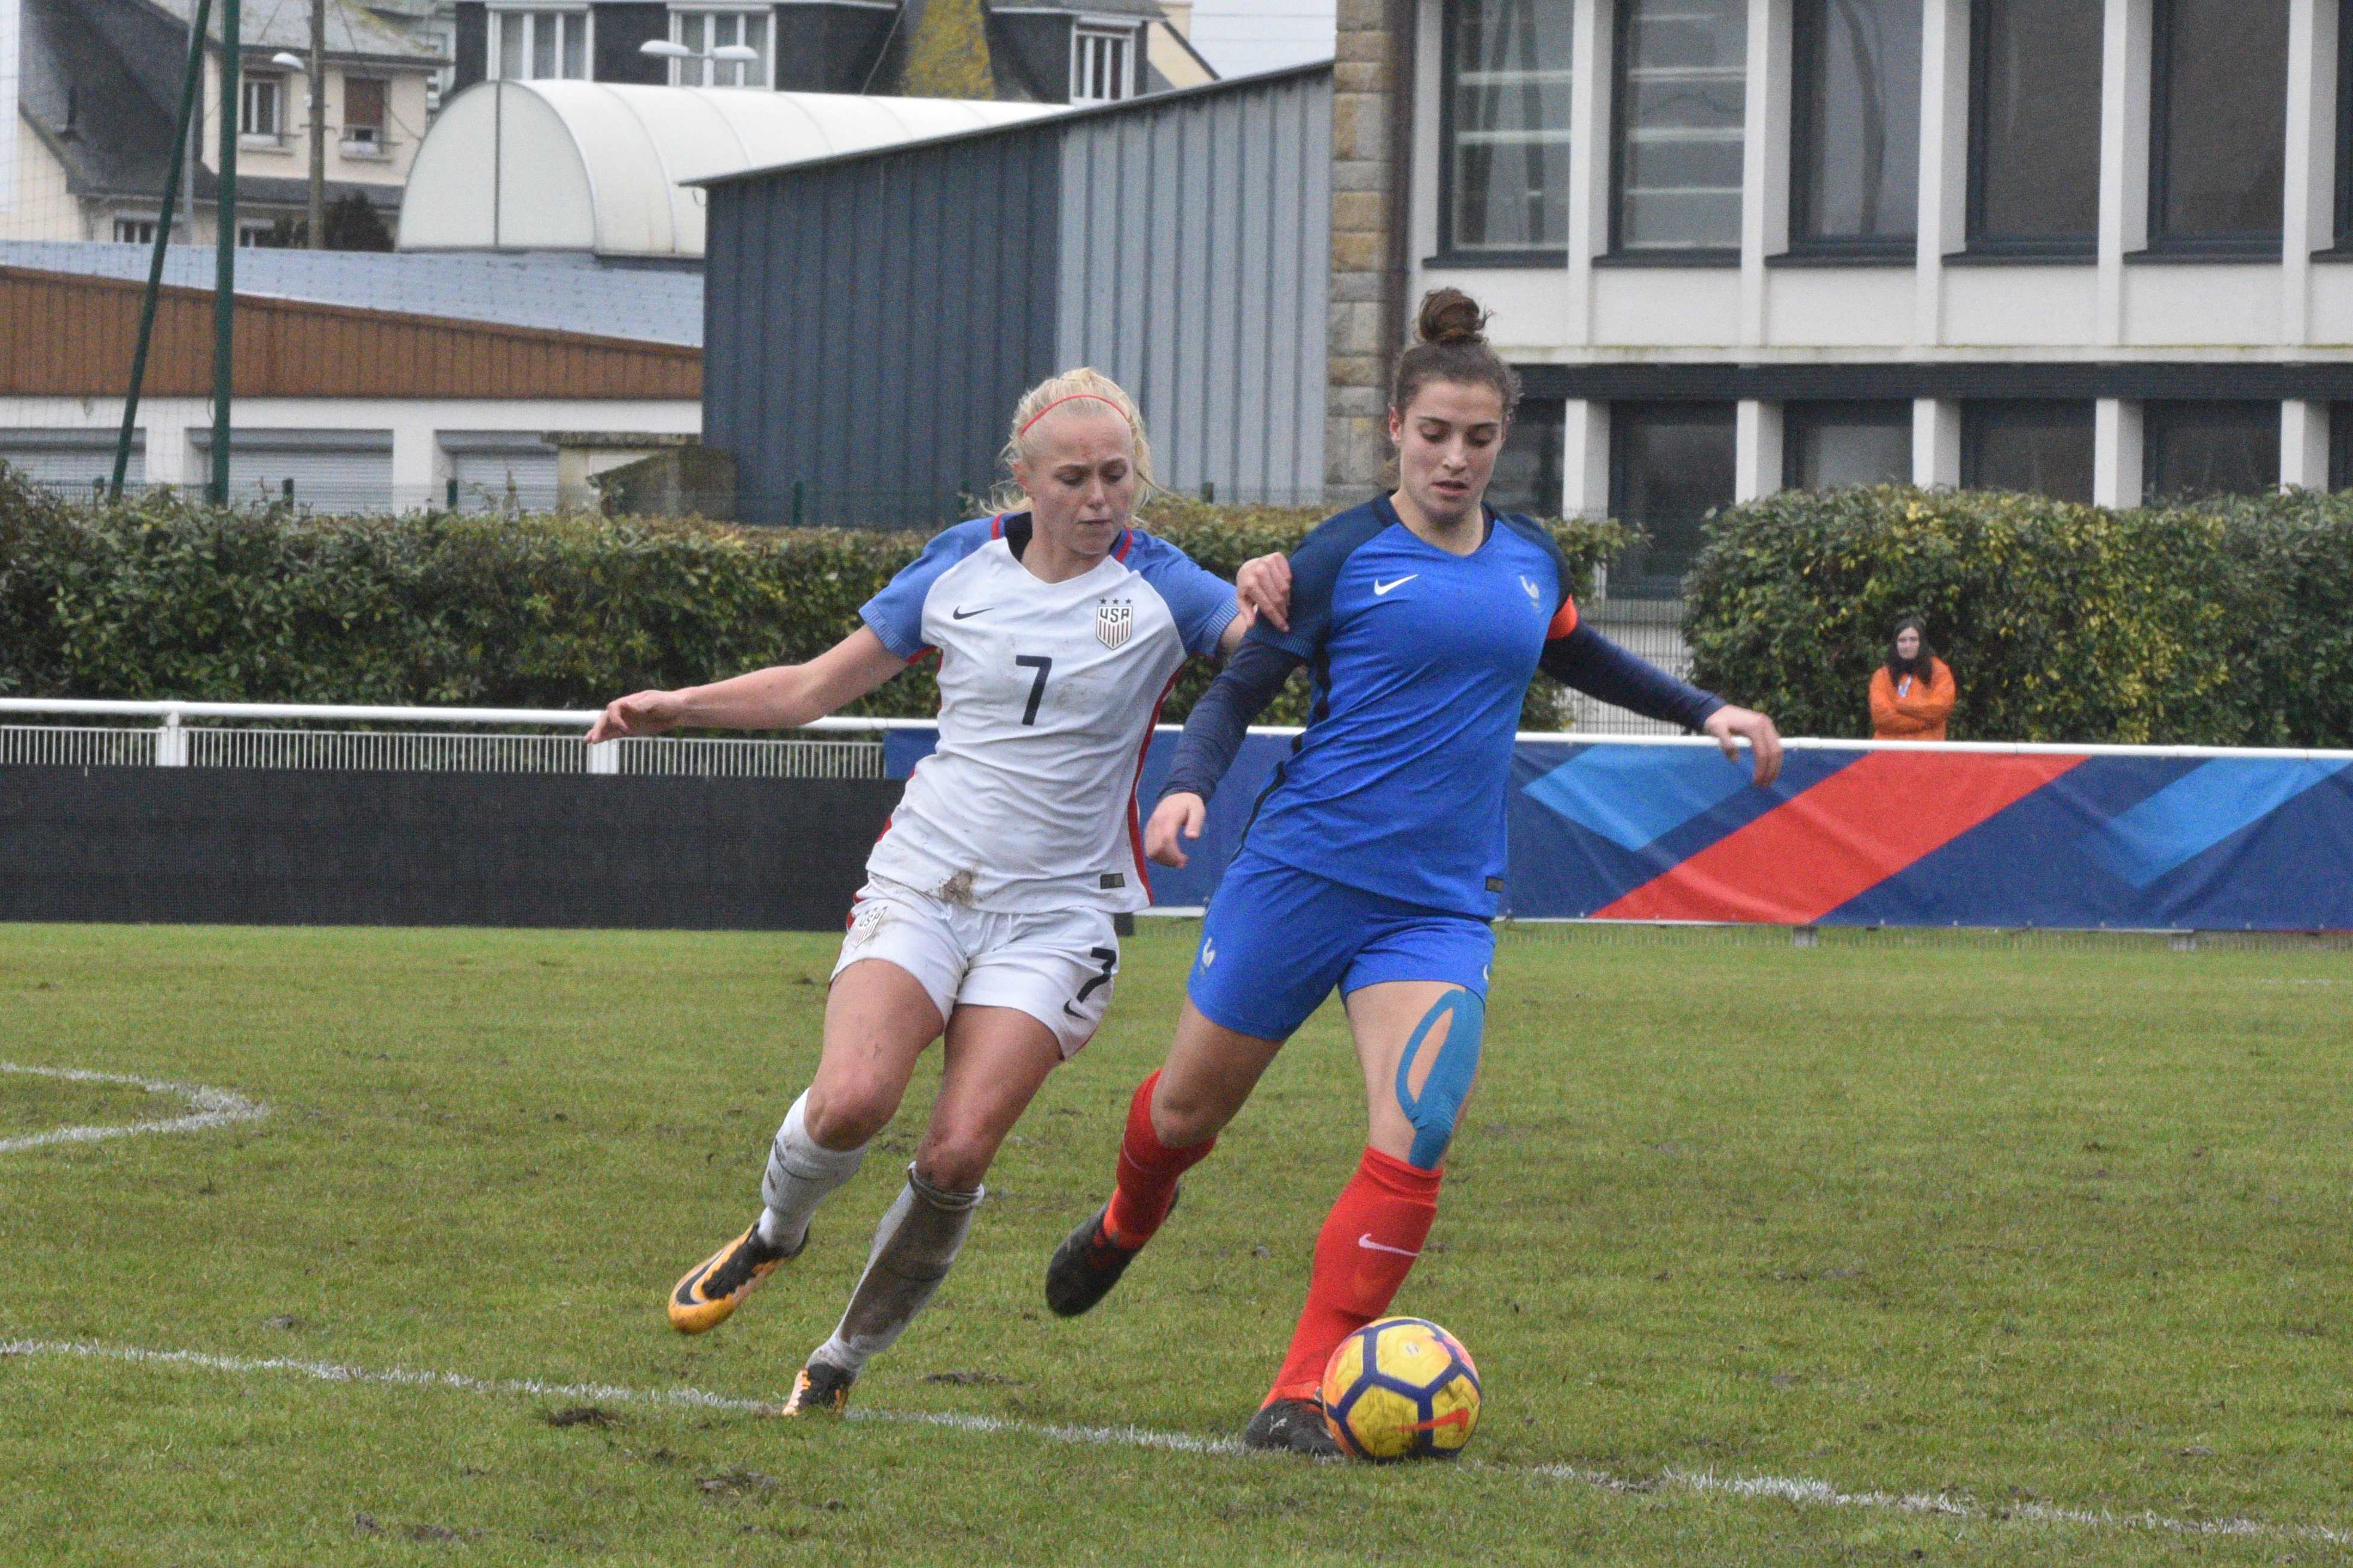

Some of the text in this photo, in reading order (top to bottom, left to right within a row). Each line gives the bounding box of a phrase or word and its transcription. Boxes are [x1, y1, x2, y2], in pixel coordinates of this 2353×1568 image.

[1100, 608, 1130, 622] USA
[1016, 655, 1053, 726] 7
[859, 912, 881, 927] USA
[1076, 947, 1117, 1004] 7
